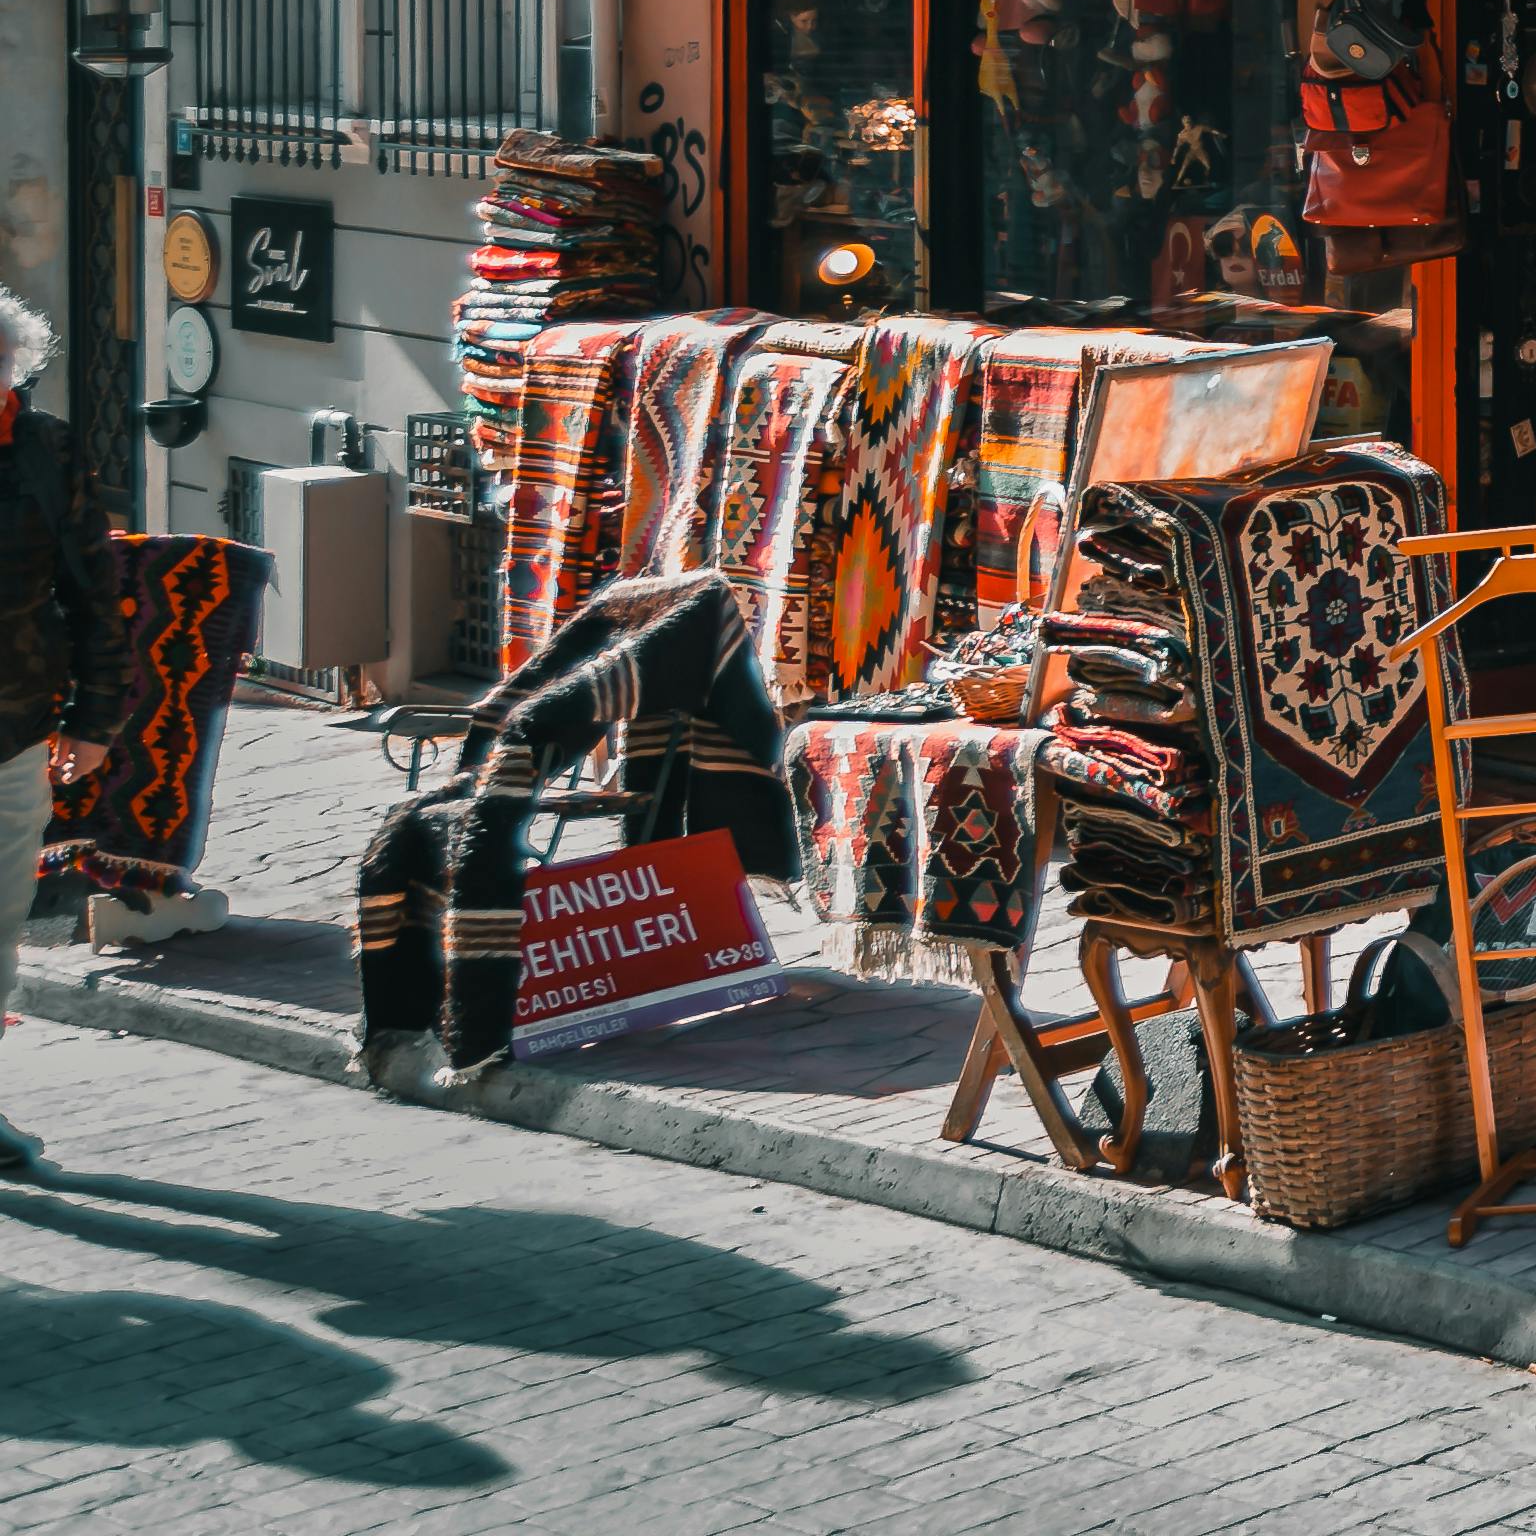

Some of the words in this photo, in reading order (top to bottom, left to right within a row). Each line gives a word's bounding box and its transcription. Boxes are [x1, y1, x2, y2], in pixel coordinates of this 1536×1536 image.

[1258, 269, 1301, 286] Erdal
[515, 972, 617, 1017] CADDESİ
[527, 1016, 631, 1054] BAHÇELİEVLER
